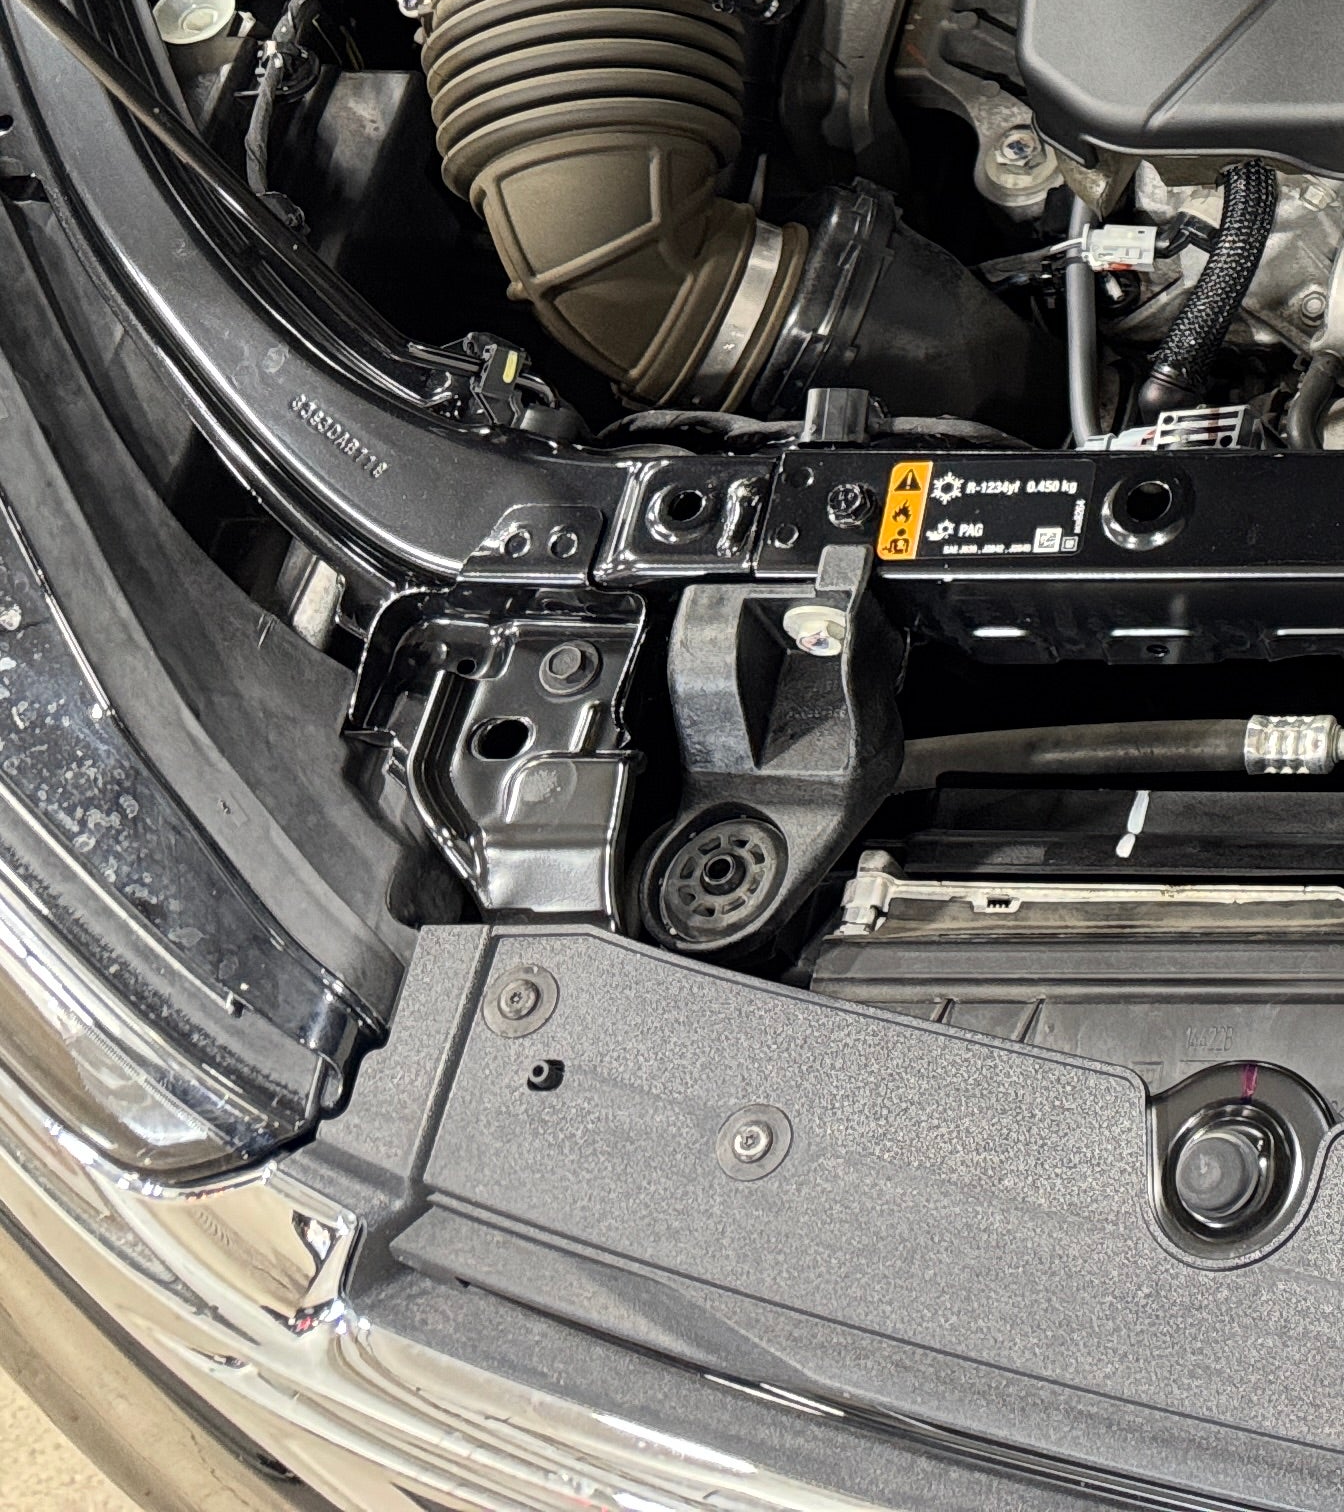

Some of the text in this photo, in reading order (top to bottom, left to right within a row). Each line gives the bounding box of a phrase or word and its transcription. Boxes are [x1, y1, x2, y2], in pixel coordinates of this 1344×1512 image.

[966, 480, 1078, 496] R-1234yf 0.450 kg
[958, 523, 984, 537] PAG
